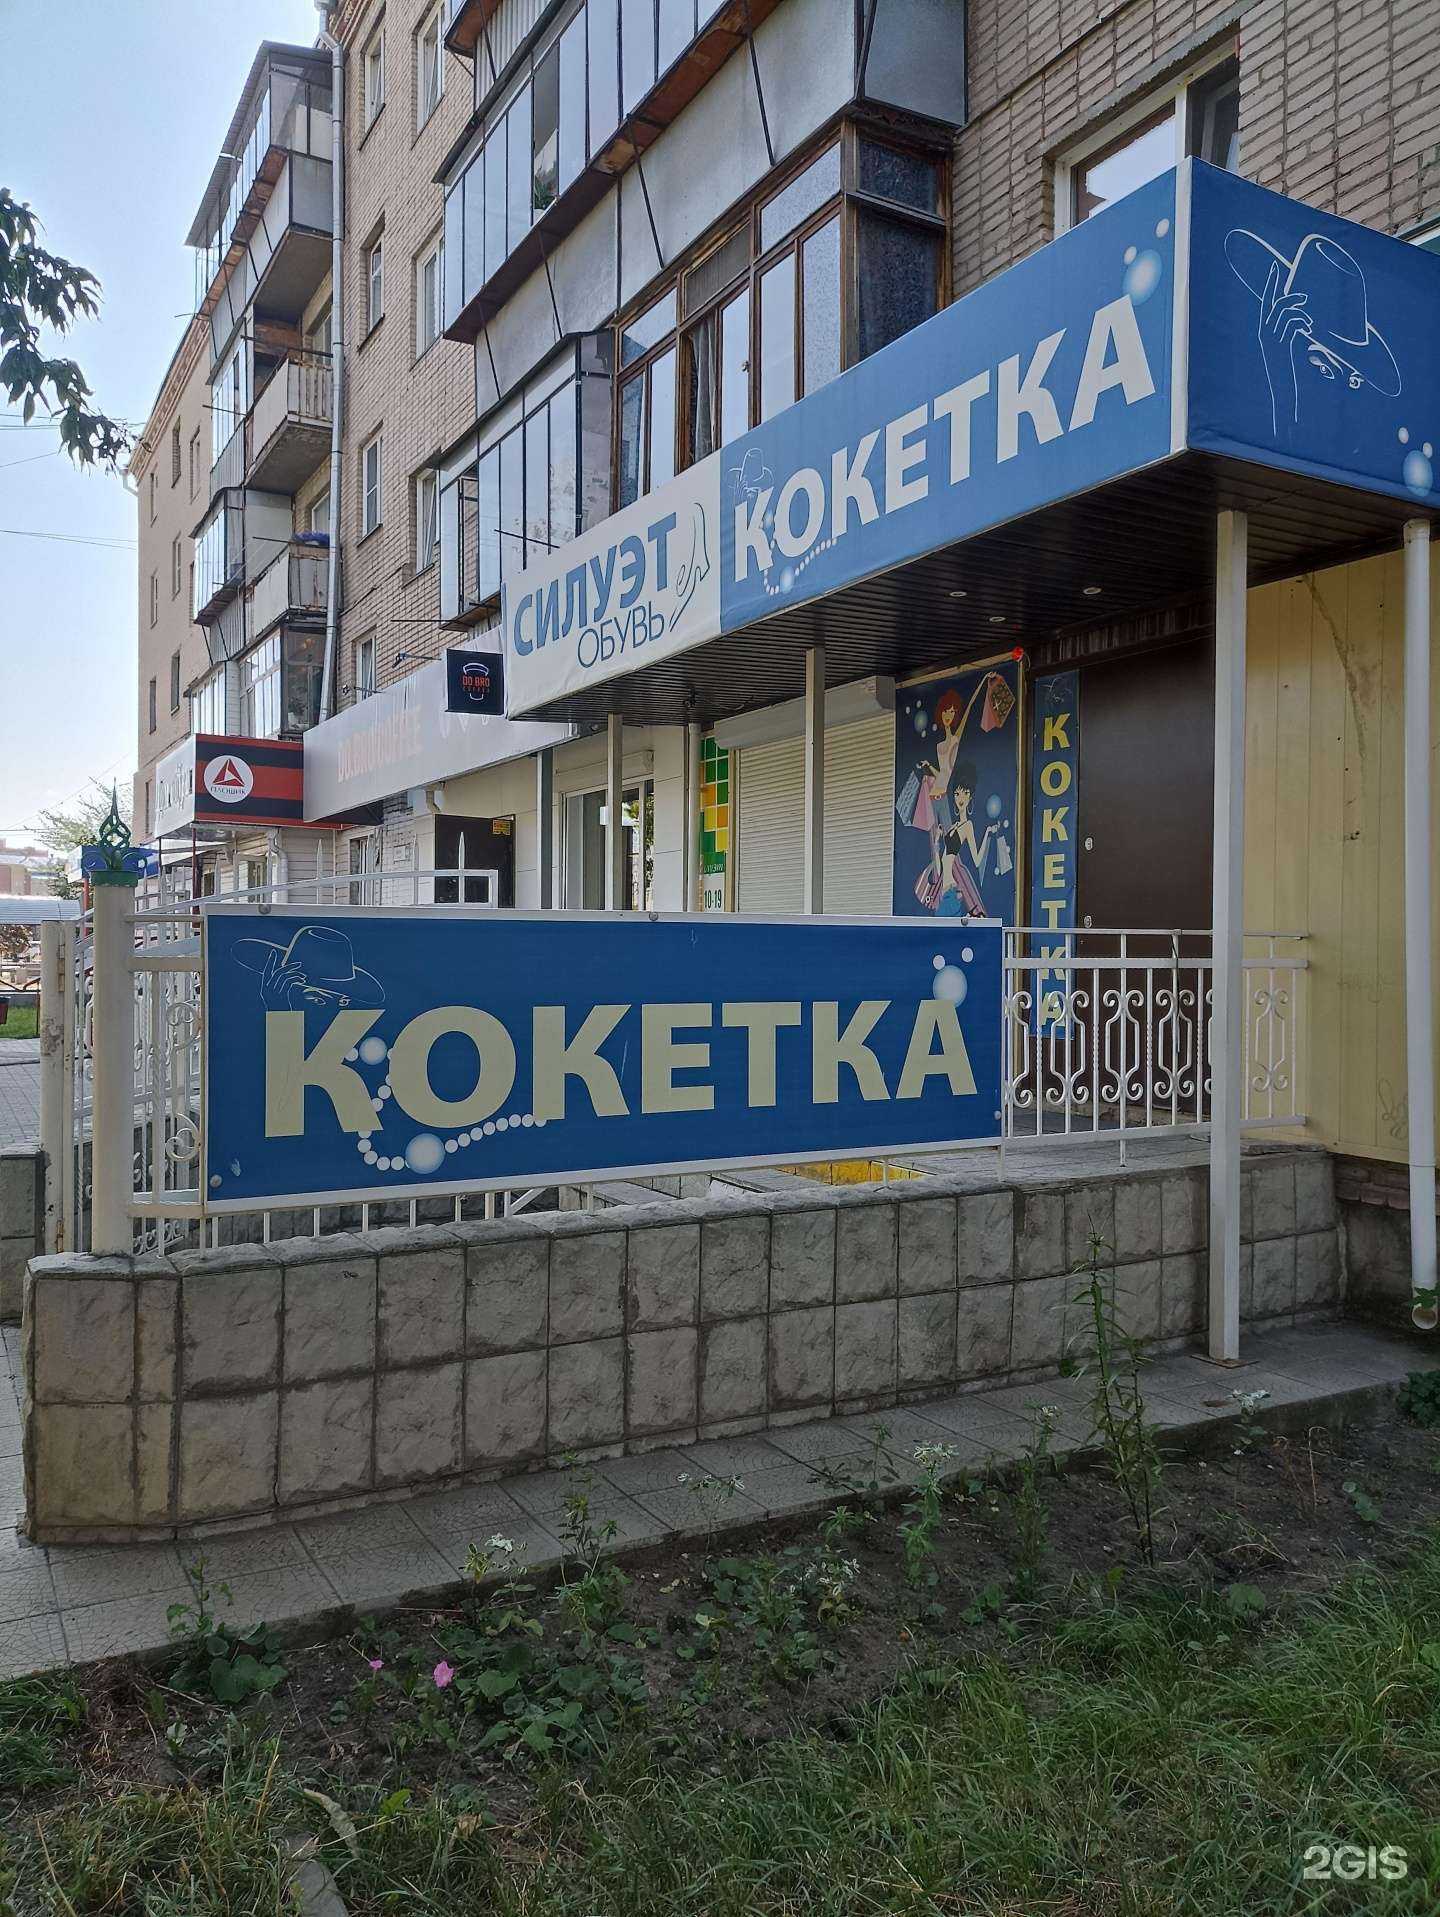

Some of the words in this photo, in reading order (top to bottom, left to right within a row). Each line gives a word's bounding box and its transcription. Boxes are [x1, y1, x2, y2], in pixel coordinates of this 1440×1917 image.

[734, 294, 1156, 583] КОКЕТКА
[514, 511, 677, 657] СИЛУЭТ
[577, 600, 665, 668] ОБУВЬ
[704, 889, 722, 909] 10-19
[1039, 713, 1072, 1027] КОКЕТКА
[265, 999, 978, 1138] КОКЕТКА
